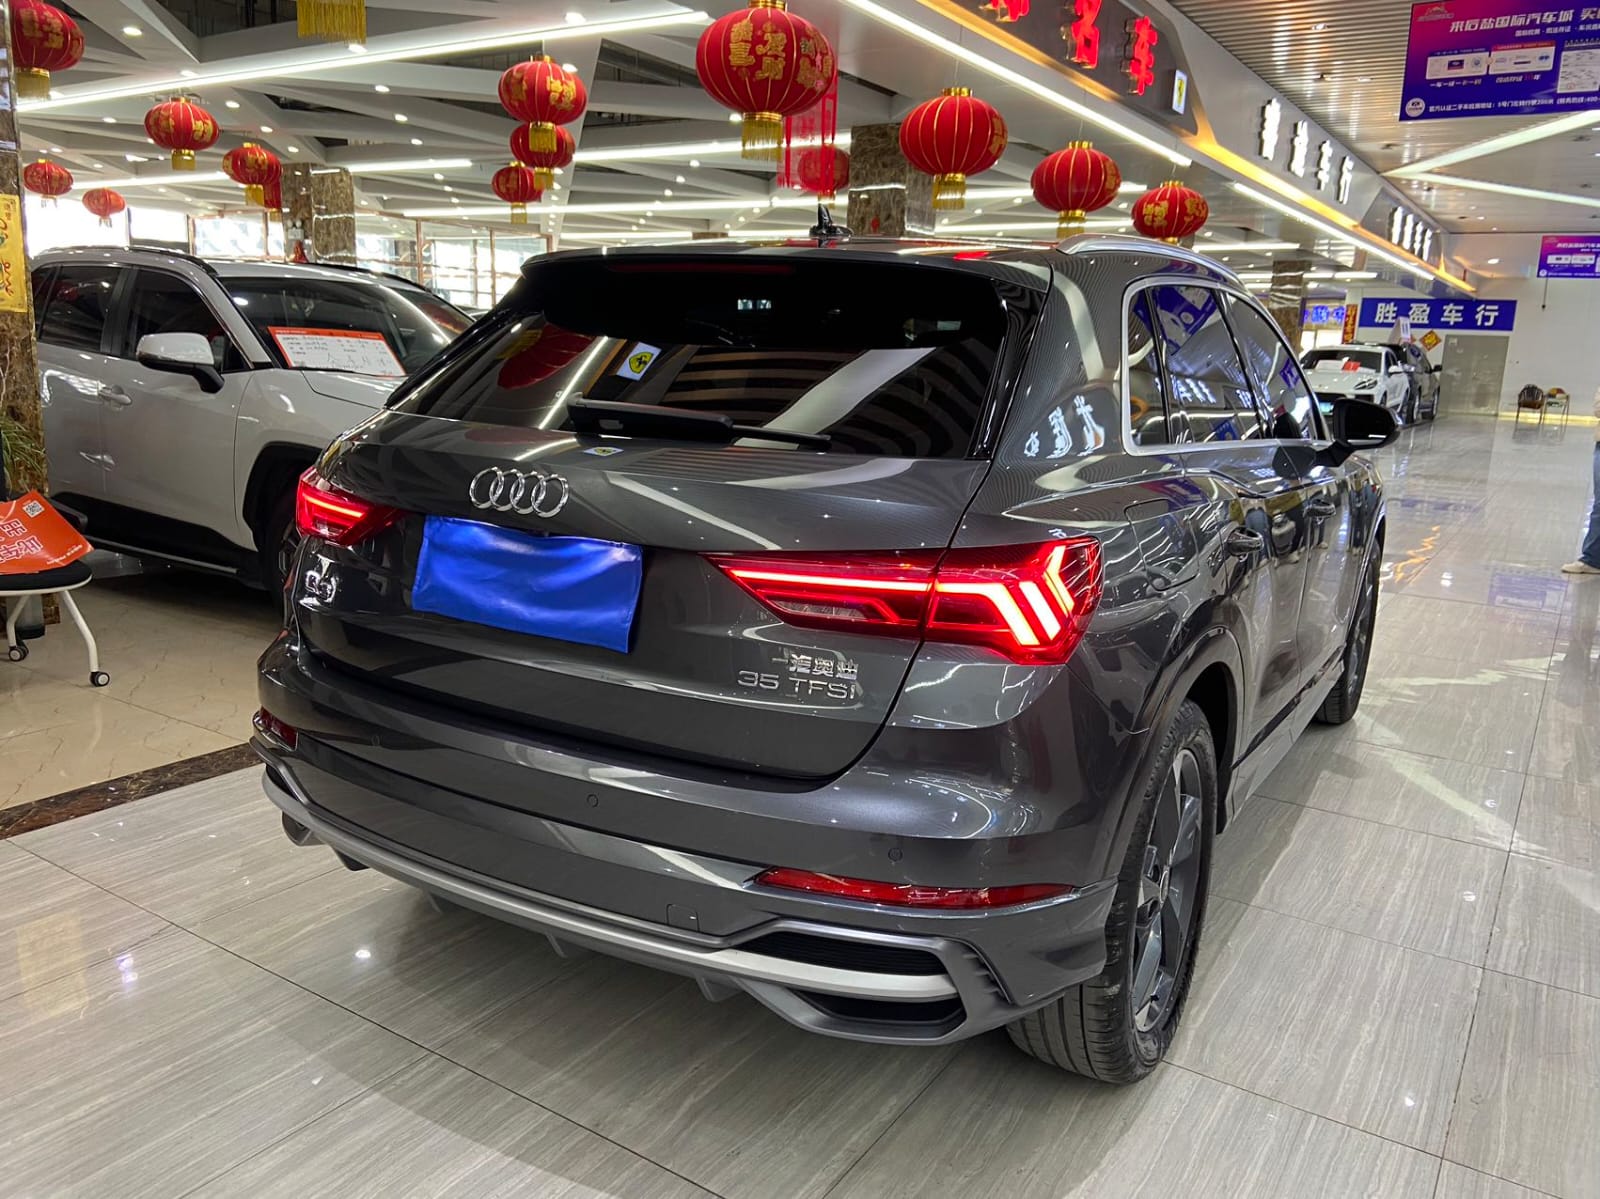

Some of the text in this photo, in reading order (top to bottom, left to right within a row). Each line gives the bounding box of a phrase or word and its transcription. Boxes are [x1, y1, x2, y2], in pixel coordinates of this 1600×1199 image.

[1375, 302, 1499, 326] 胜盈车行
[738, 670, 857, 699] 35 TFSI
